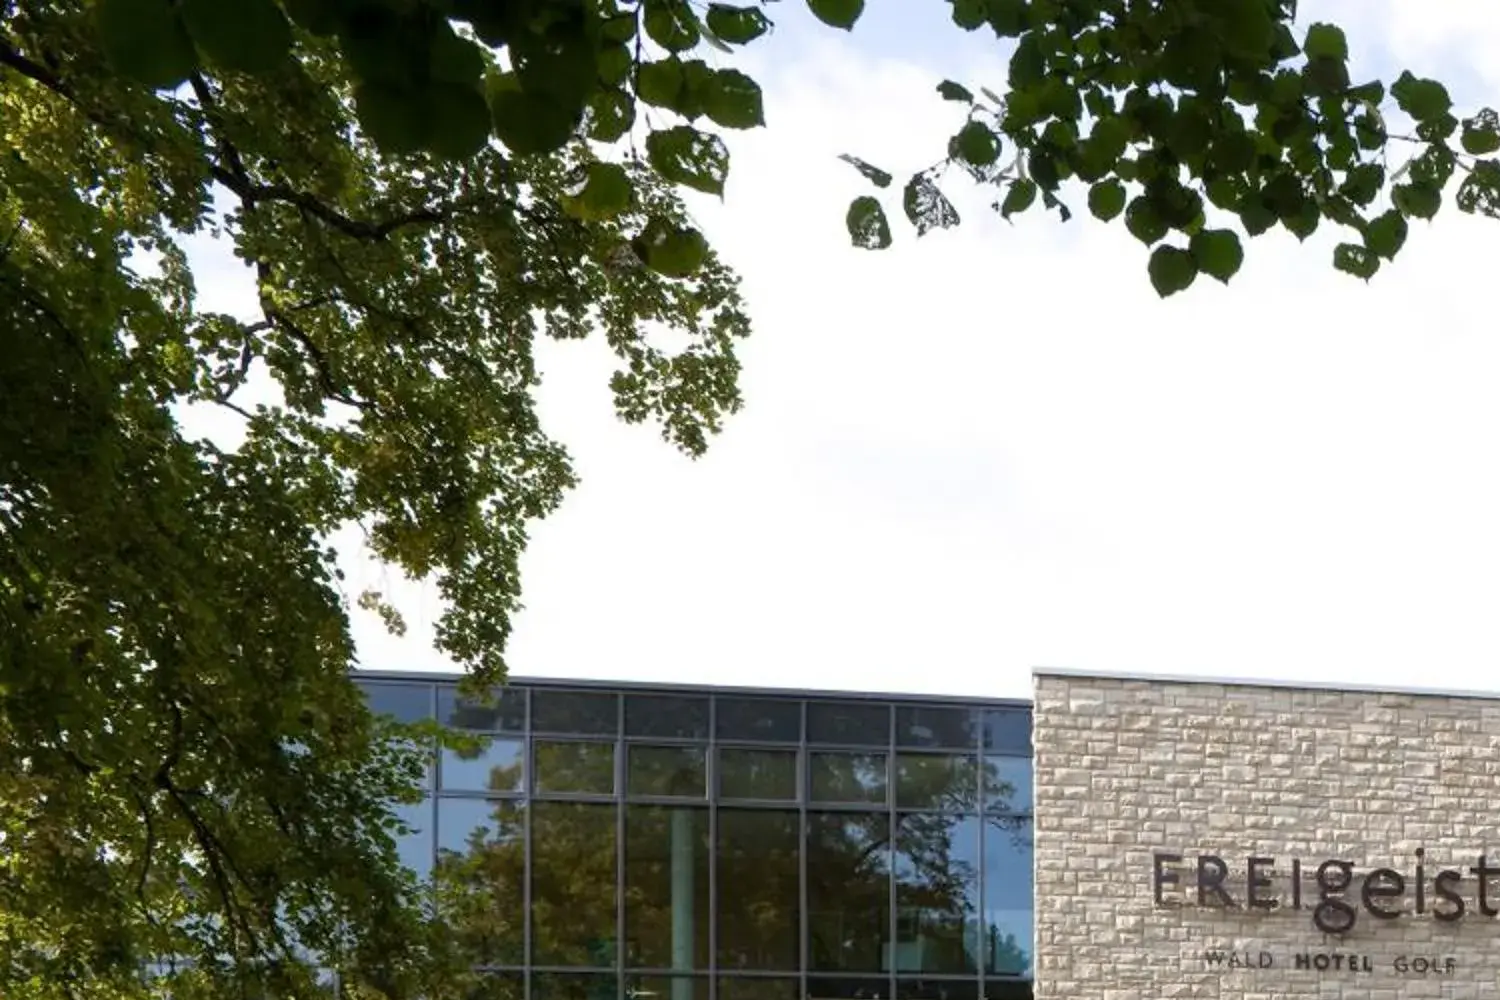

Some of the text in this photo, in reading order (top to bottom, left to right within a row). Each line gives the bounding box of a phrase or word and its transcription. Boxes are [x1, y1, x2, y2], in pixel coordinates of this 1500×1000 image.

[1206, 951, 1457, 975] WALD HOTEL GOLF
